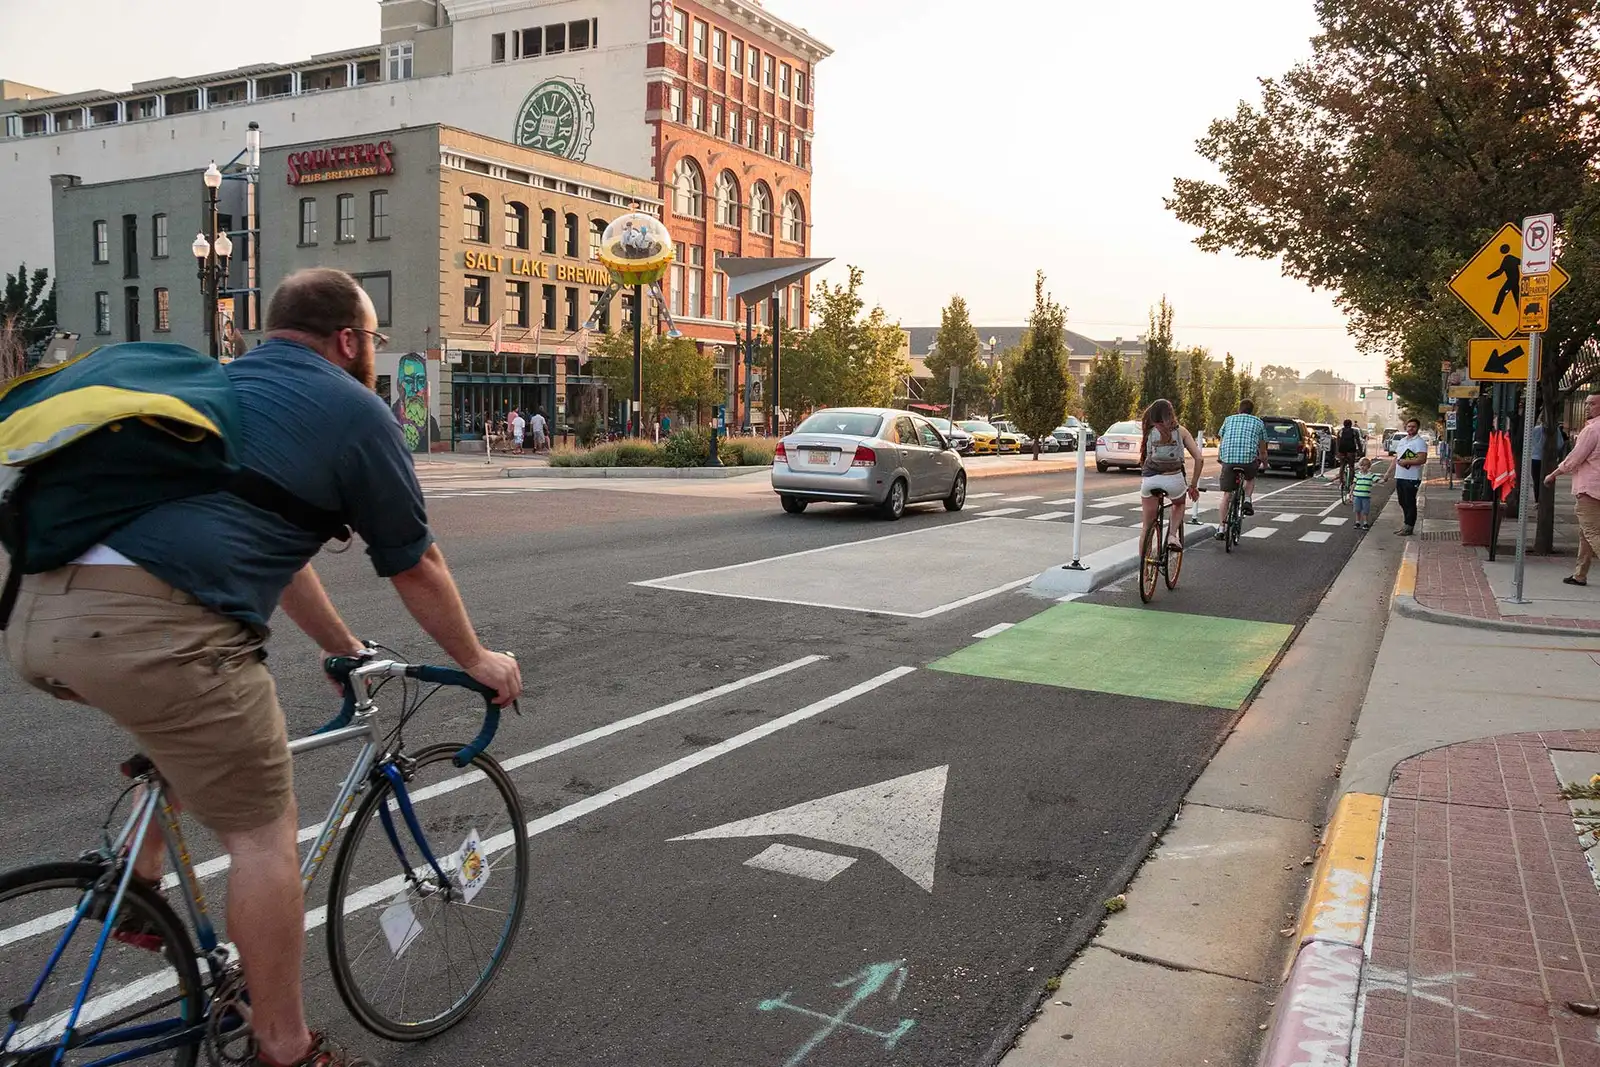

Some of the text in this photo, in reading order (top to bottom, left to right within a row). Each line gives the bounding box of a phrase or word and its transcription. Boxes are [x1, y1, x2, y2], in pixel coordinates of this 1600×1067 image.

[522, 93, 572, 153] SQUATTERS
[287, 140, 393, 185] SQUATTERS
[300, 166, 377, 183] PUB BREWERY
[465, 250, 504, 273] SALT
[511, 258, 549, 279] LAKE
